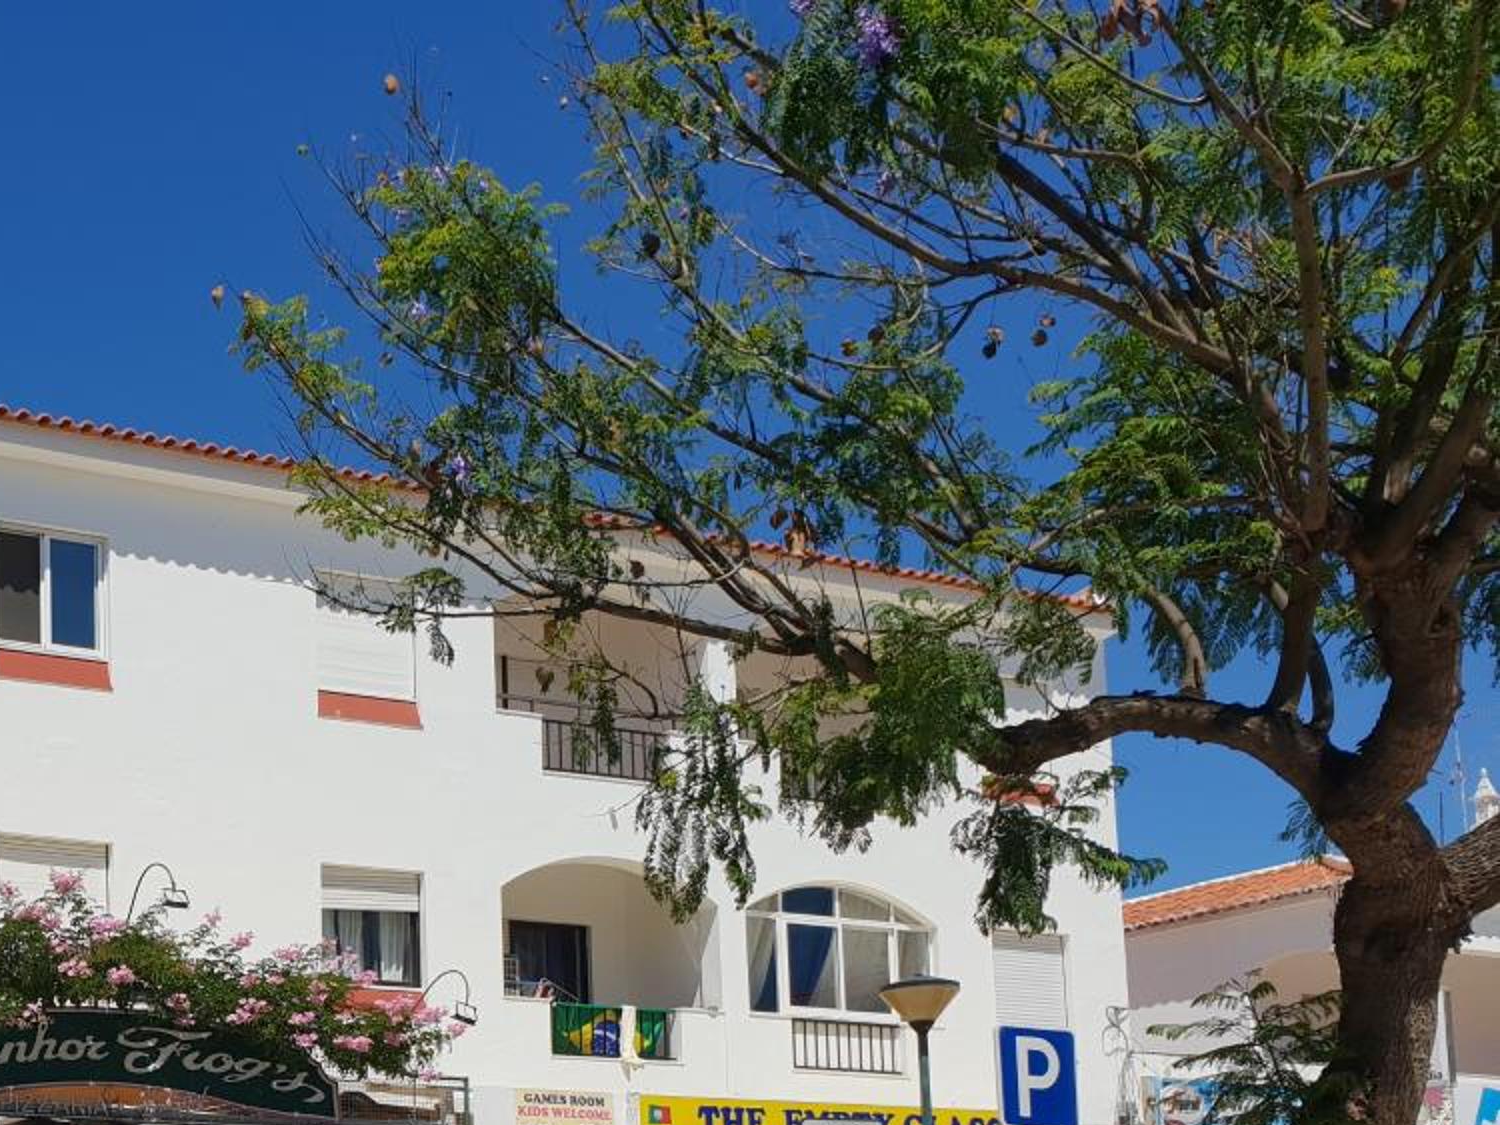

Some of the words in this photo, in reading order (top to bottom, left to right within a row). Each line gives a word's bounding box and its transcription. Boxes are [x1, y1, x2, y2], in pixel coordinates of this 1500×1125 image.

[117, 1026, 326, 1104] Frog's
[1015, 1035, 1061, 1119] P
[517, 1105, 549, 1117] KIDS
[551, 1107, 613, 1121] WELCOME
[523, 1093, 567, 1105] GAMES
[569, 1095, 605, 1107] ROOM
